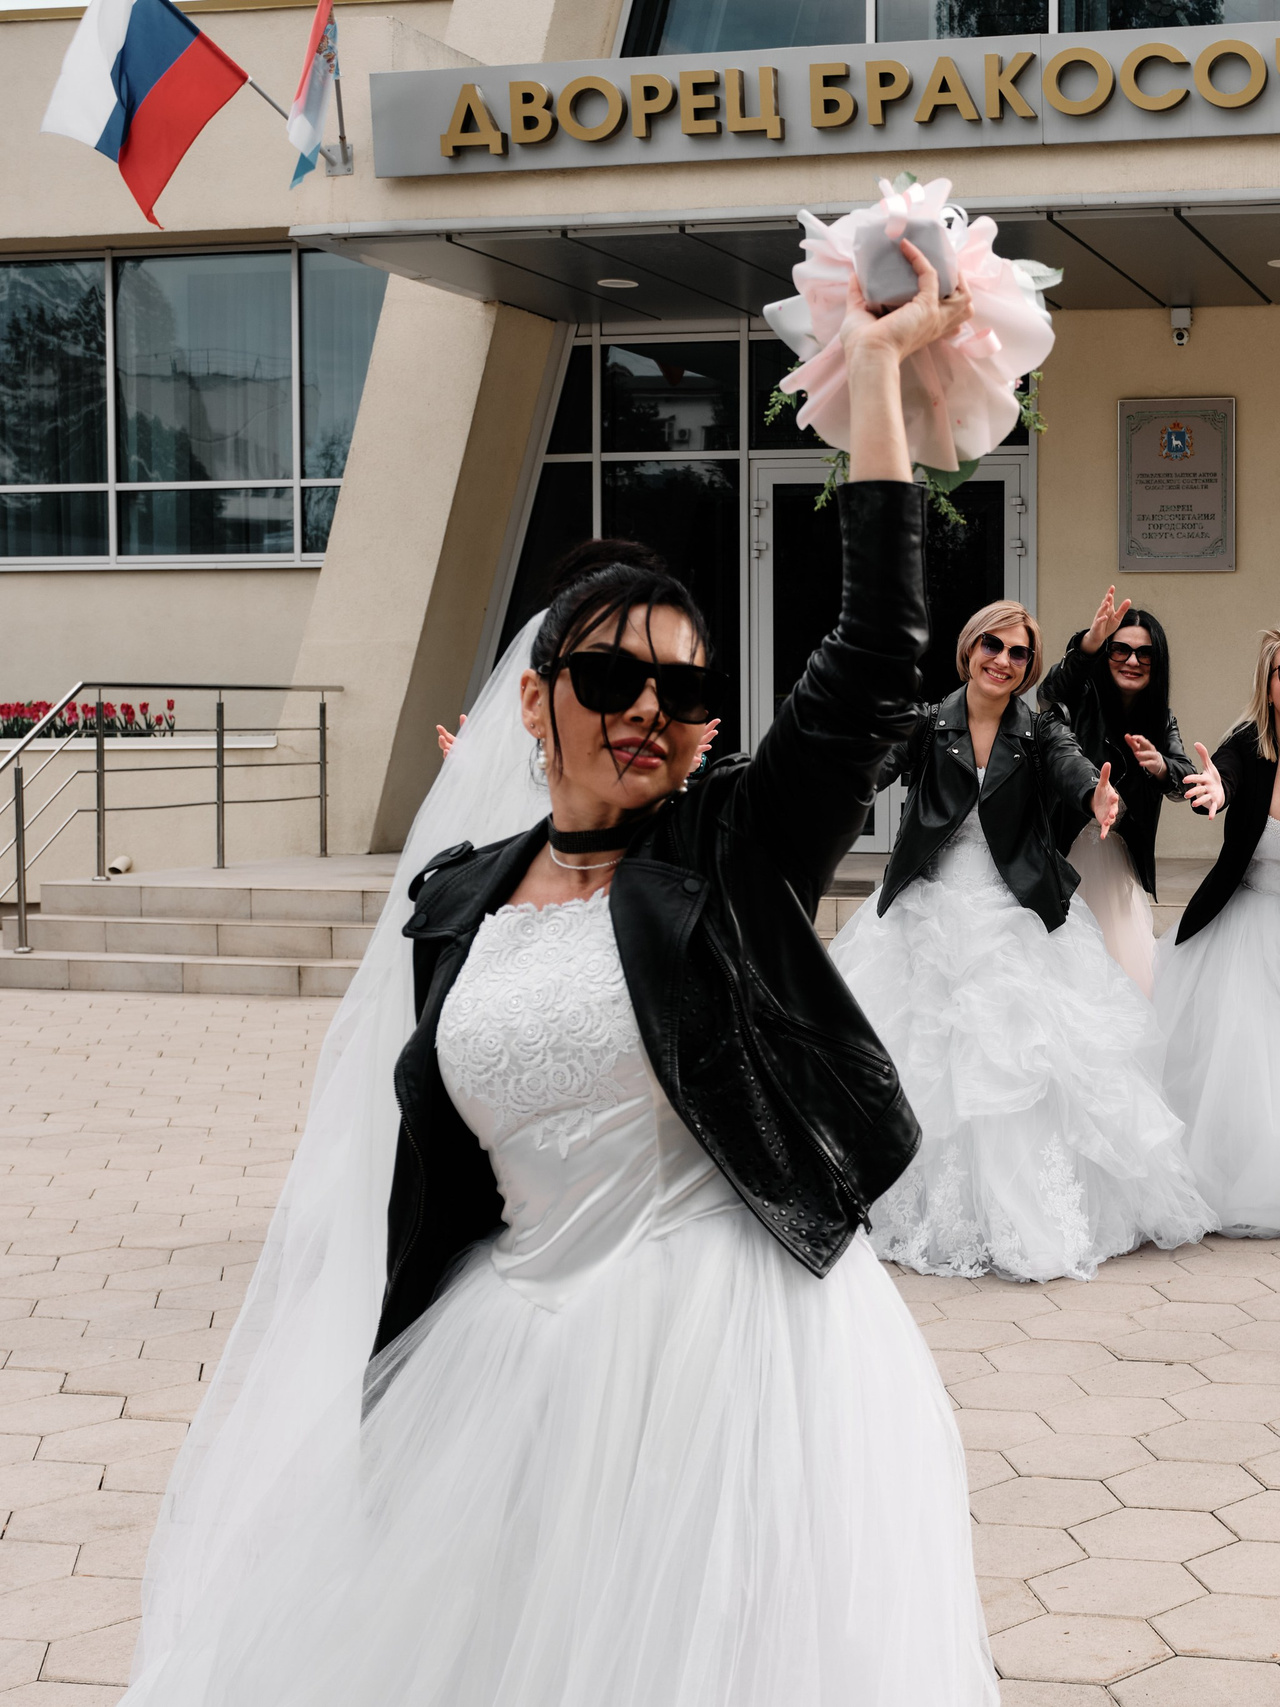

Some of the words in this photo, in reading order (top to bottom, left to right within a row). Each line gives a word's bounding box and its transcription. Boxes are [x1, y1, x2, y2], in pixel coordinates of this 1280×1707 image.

[440, 66, 785, 157] ДВОРЕЦ
[1159, 504, 1193, 512] ДВОРЕЦ
[1136, 513, 1216, 521] БРАКОСОЧЕТАНИЯ
[1147, 522, 1204, 531] ГОРОДСКОГО
